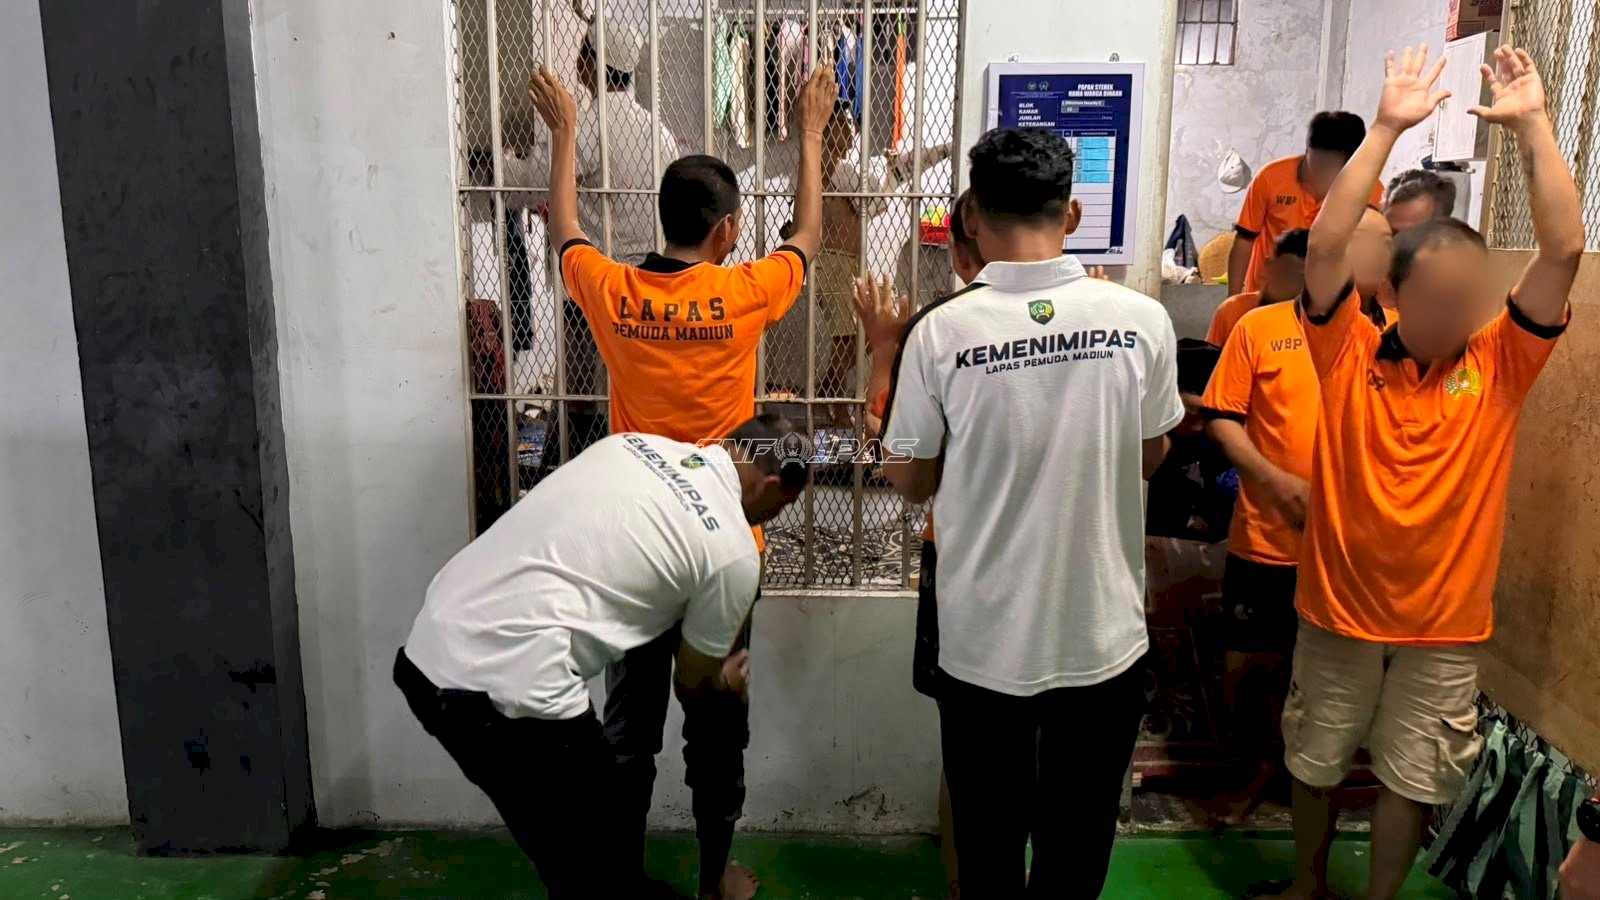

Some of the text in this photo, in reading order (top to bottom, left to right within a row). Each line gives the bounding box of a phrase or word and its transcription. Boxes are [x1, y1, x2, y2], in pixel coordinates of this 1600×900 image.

[620, 295, 726, 322] LAPAS
[612, 322, 734, 341] PEMUDA MADIUN
[955, 329, 1138, 369] KEMENIMIPAS
[1270, 337, 1303, 352] WBP
[985, 350, 1114, 375] LAPAS PEMUDA MADIUN
